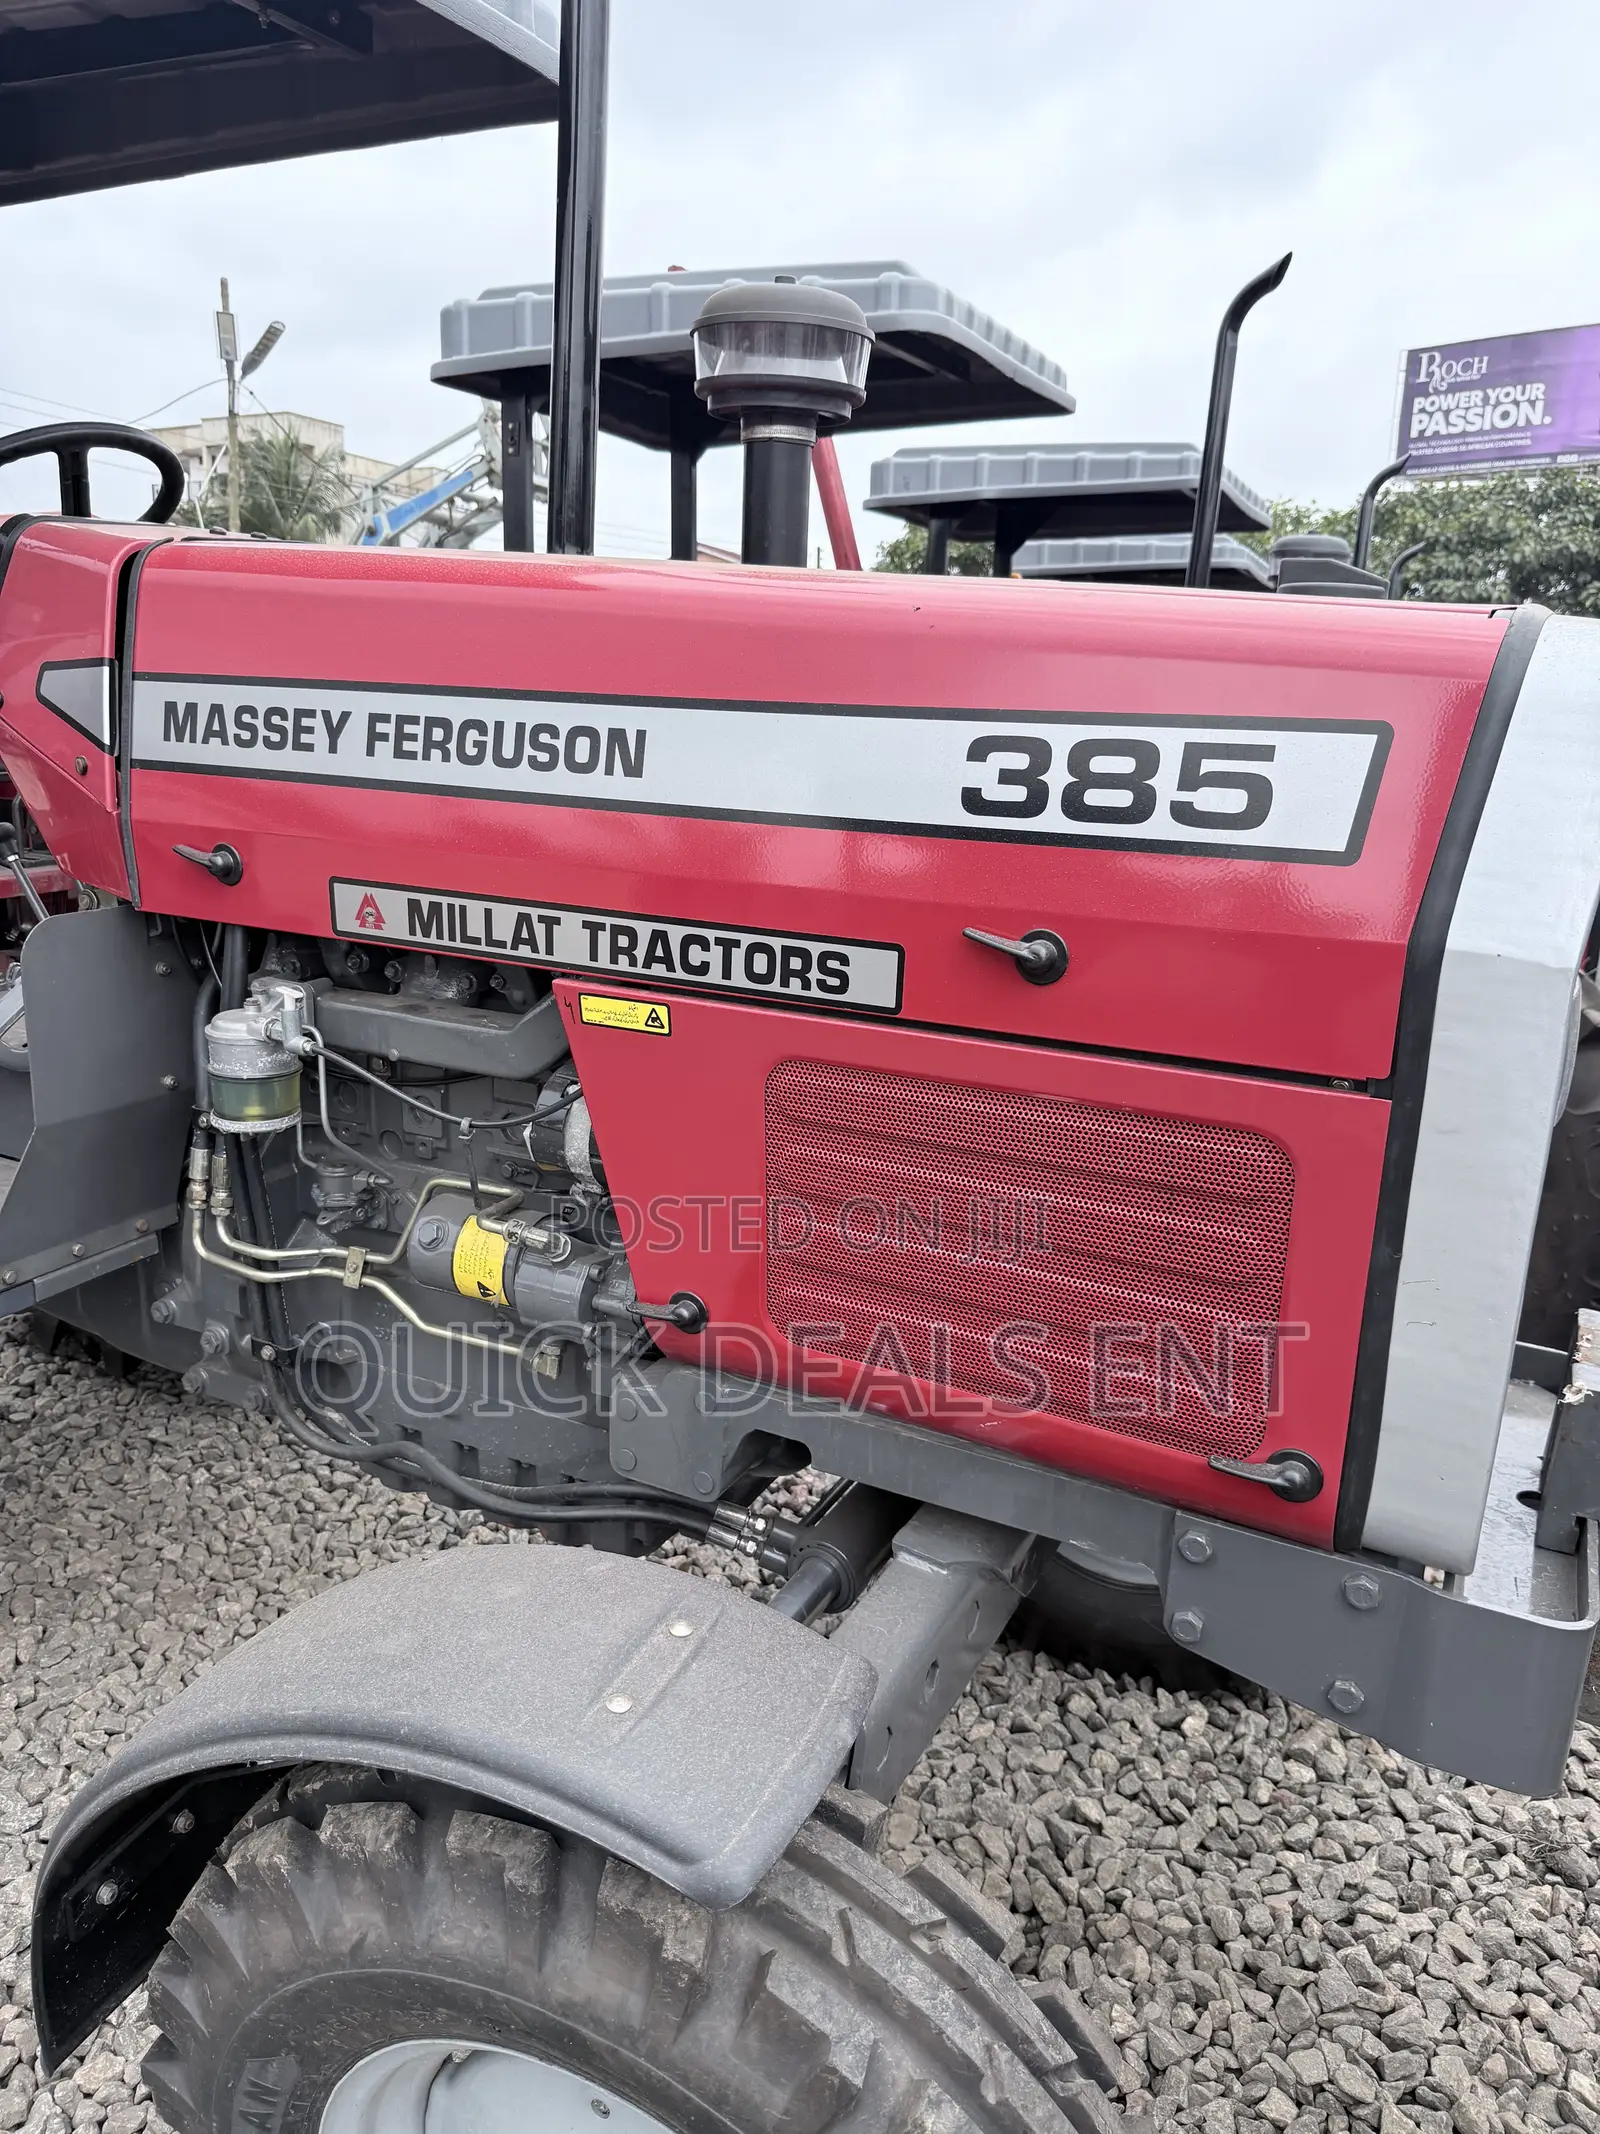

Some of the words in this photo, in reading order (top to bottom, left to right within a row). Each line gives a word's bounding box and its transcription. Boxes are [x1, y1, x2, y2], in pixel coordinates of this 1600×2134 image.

[1409, 400, 1553, 439] PASSION.
[1412, 389, 1485, 414] POWER
[1485, 382, 1546, 405] YOUR
[163, 700, 352, 755] MASSEY
[365, 712, 647, 779] FERGUSON
[960, 735, 1277, 831] 385
[406, 897, 562, 957] MILLAT
[581, 919, 850, 995] TRACTORS
